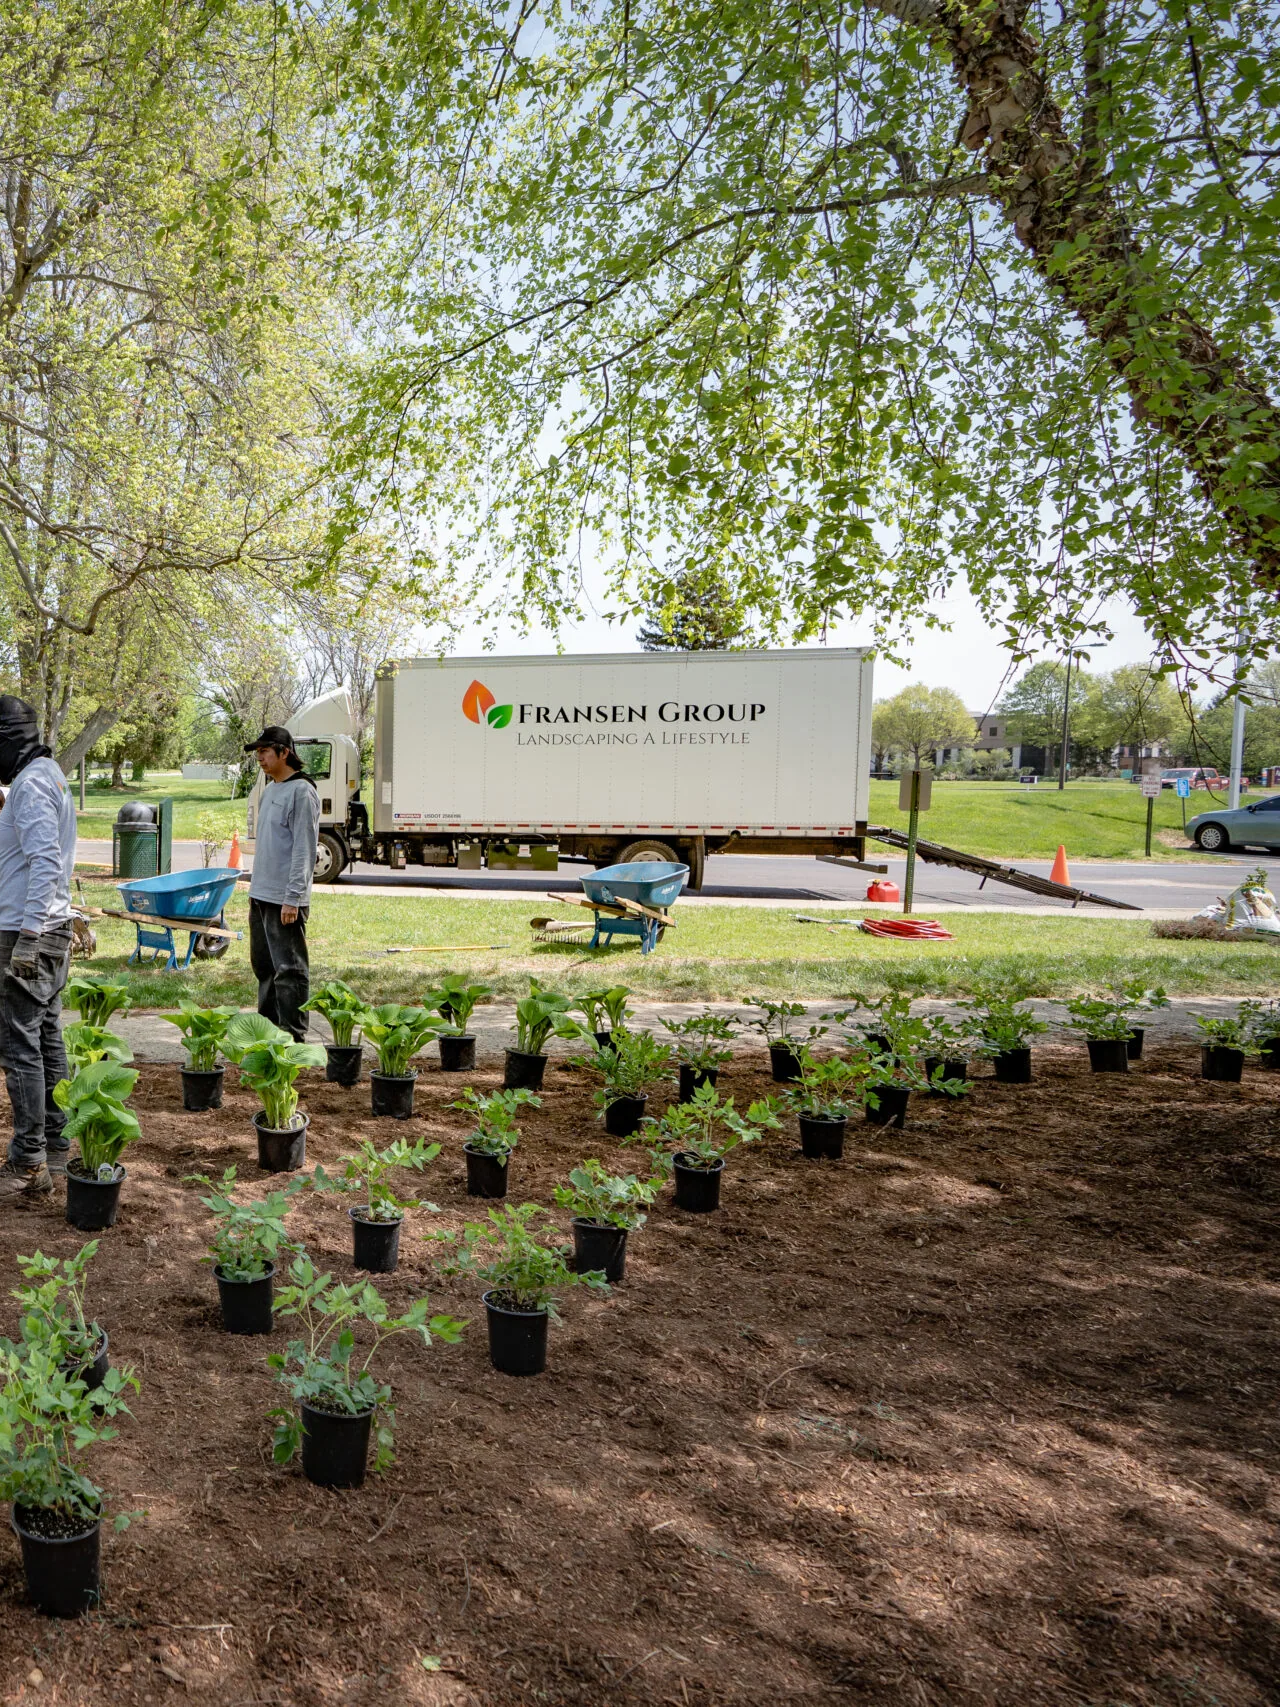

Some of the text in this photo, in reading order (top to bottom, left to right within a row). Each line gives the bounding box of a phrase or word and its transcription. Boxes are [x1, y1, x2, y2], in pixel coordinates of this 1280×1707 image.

[518, 701, 767, 724] FRANSEN GROUP
[517, 731, 751, 746] LANDSCAPING A LIFESTYLE
